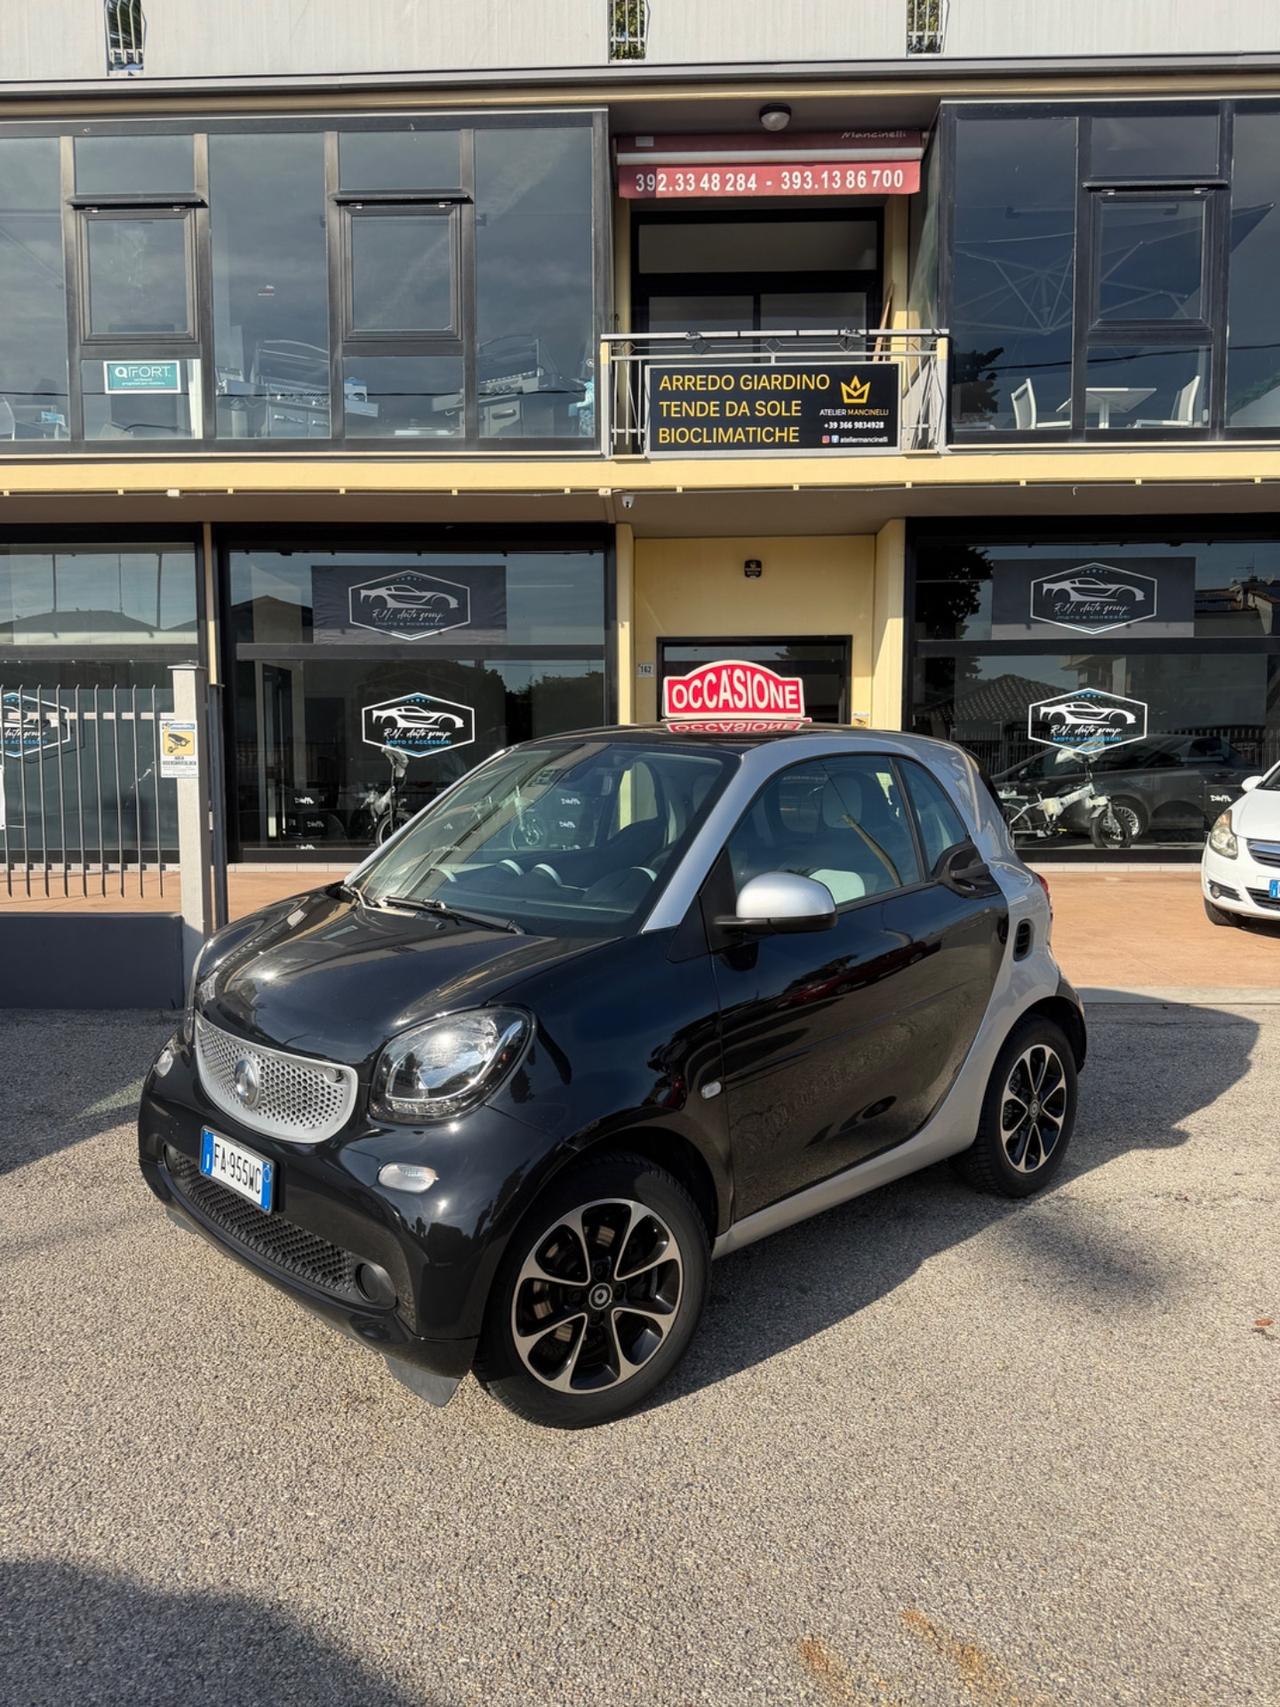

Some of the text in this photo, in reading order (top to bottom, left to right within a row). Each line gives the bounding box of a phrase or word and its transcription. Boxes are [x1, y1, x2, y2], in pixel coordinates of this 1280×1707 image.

[659, 374, 830, 391] ARREDO GIARDINO
[659, 400, 802, 417] TENDE DA SOLE
[819, 408, 889, 416] ATELIER MANCINELLI
[824, 421, 838, 429] +39
[659, 427, 799, 443] BIOCLIMATICHE
[672, 668, 799, 709] OCCASIONE
[427, 731, 452, 741] group
[1096, 728, 1122, 738] group
